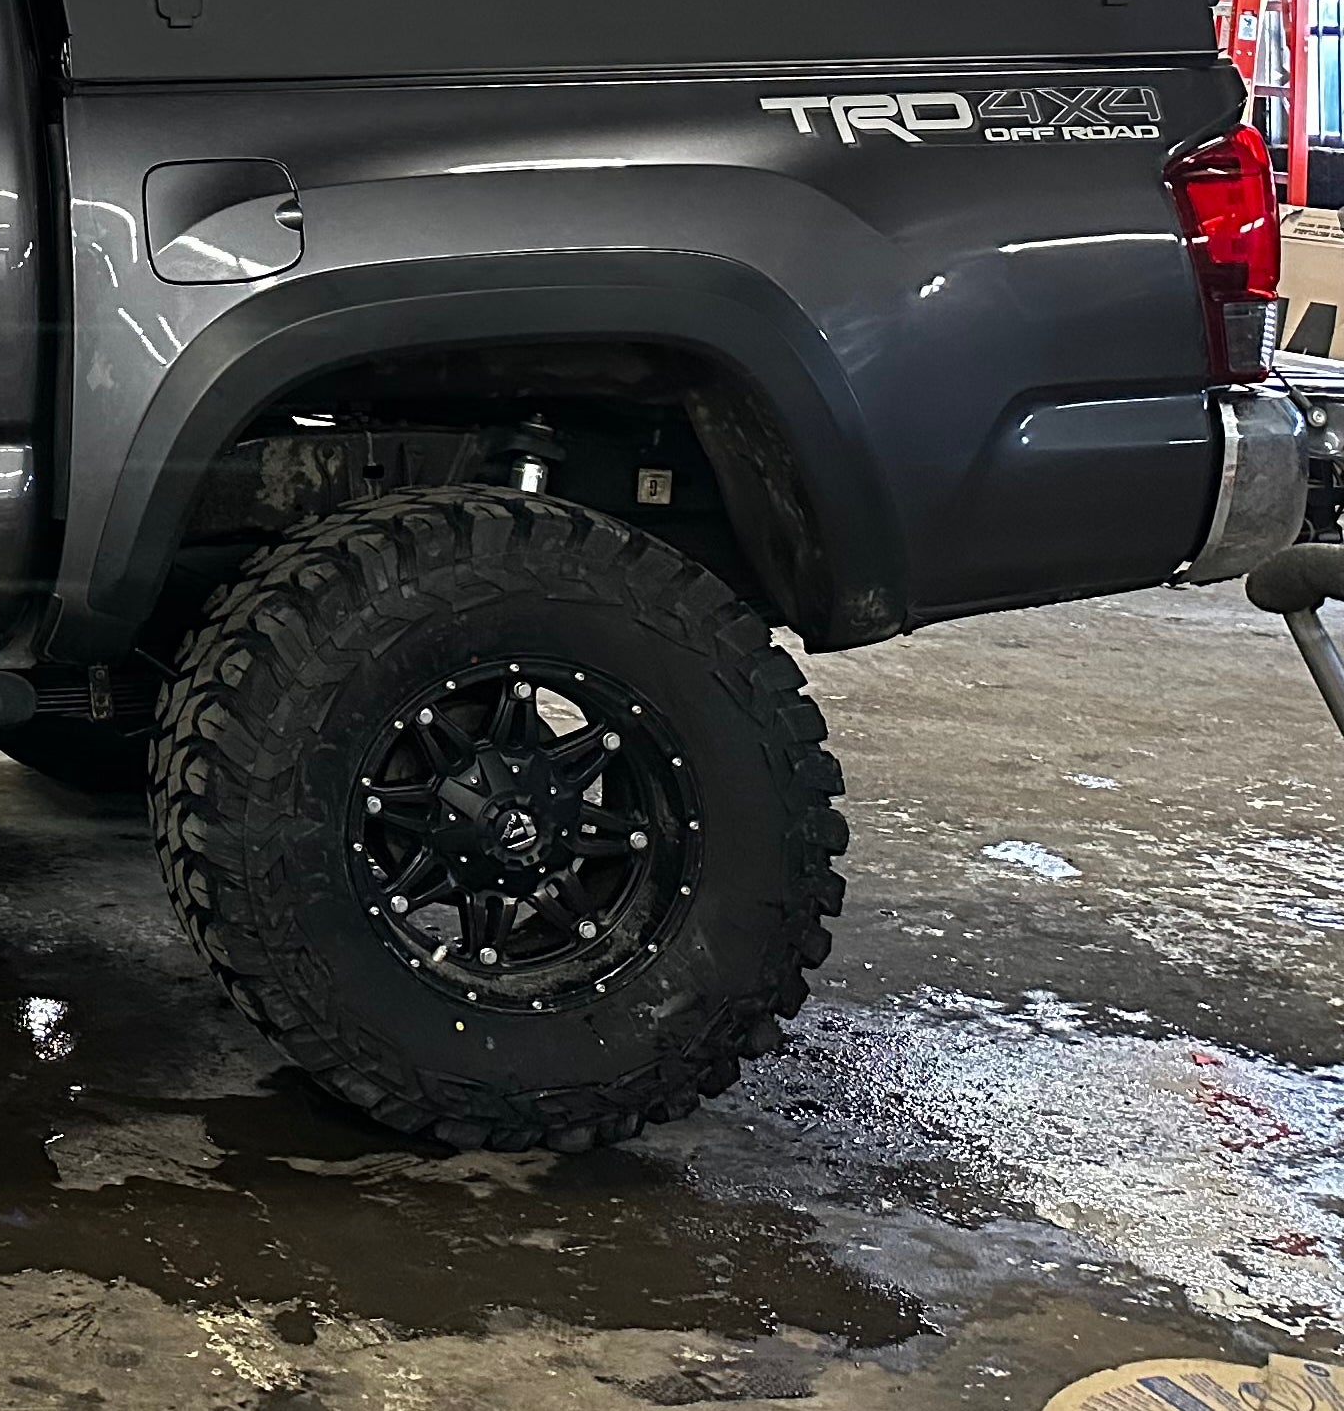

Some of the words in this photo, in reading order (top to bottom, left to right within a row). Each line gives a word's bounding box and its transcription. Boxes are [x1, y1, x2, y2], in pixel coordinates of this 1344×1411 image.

[760, 93, 974, 144] TRD
[984, 126, 1055, 142] OFF
[1062, 124, 1160, 141] ROAD
